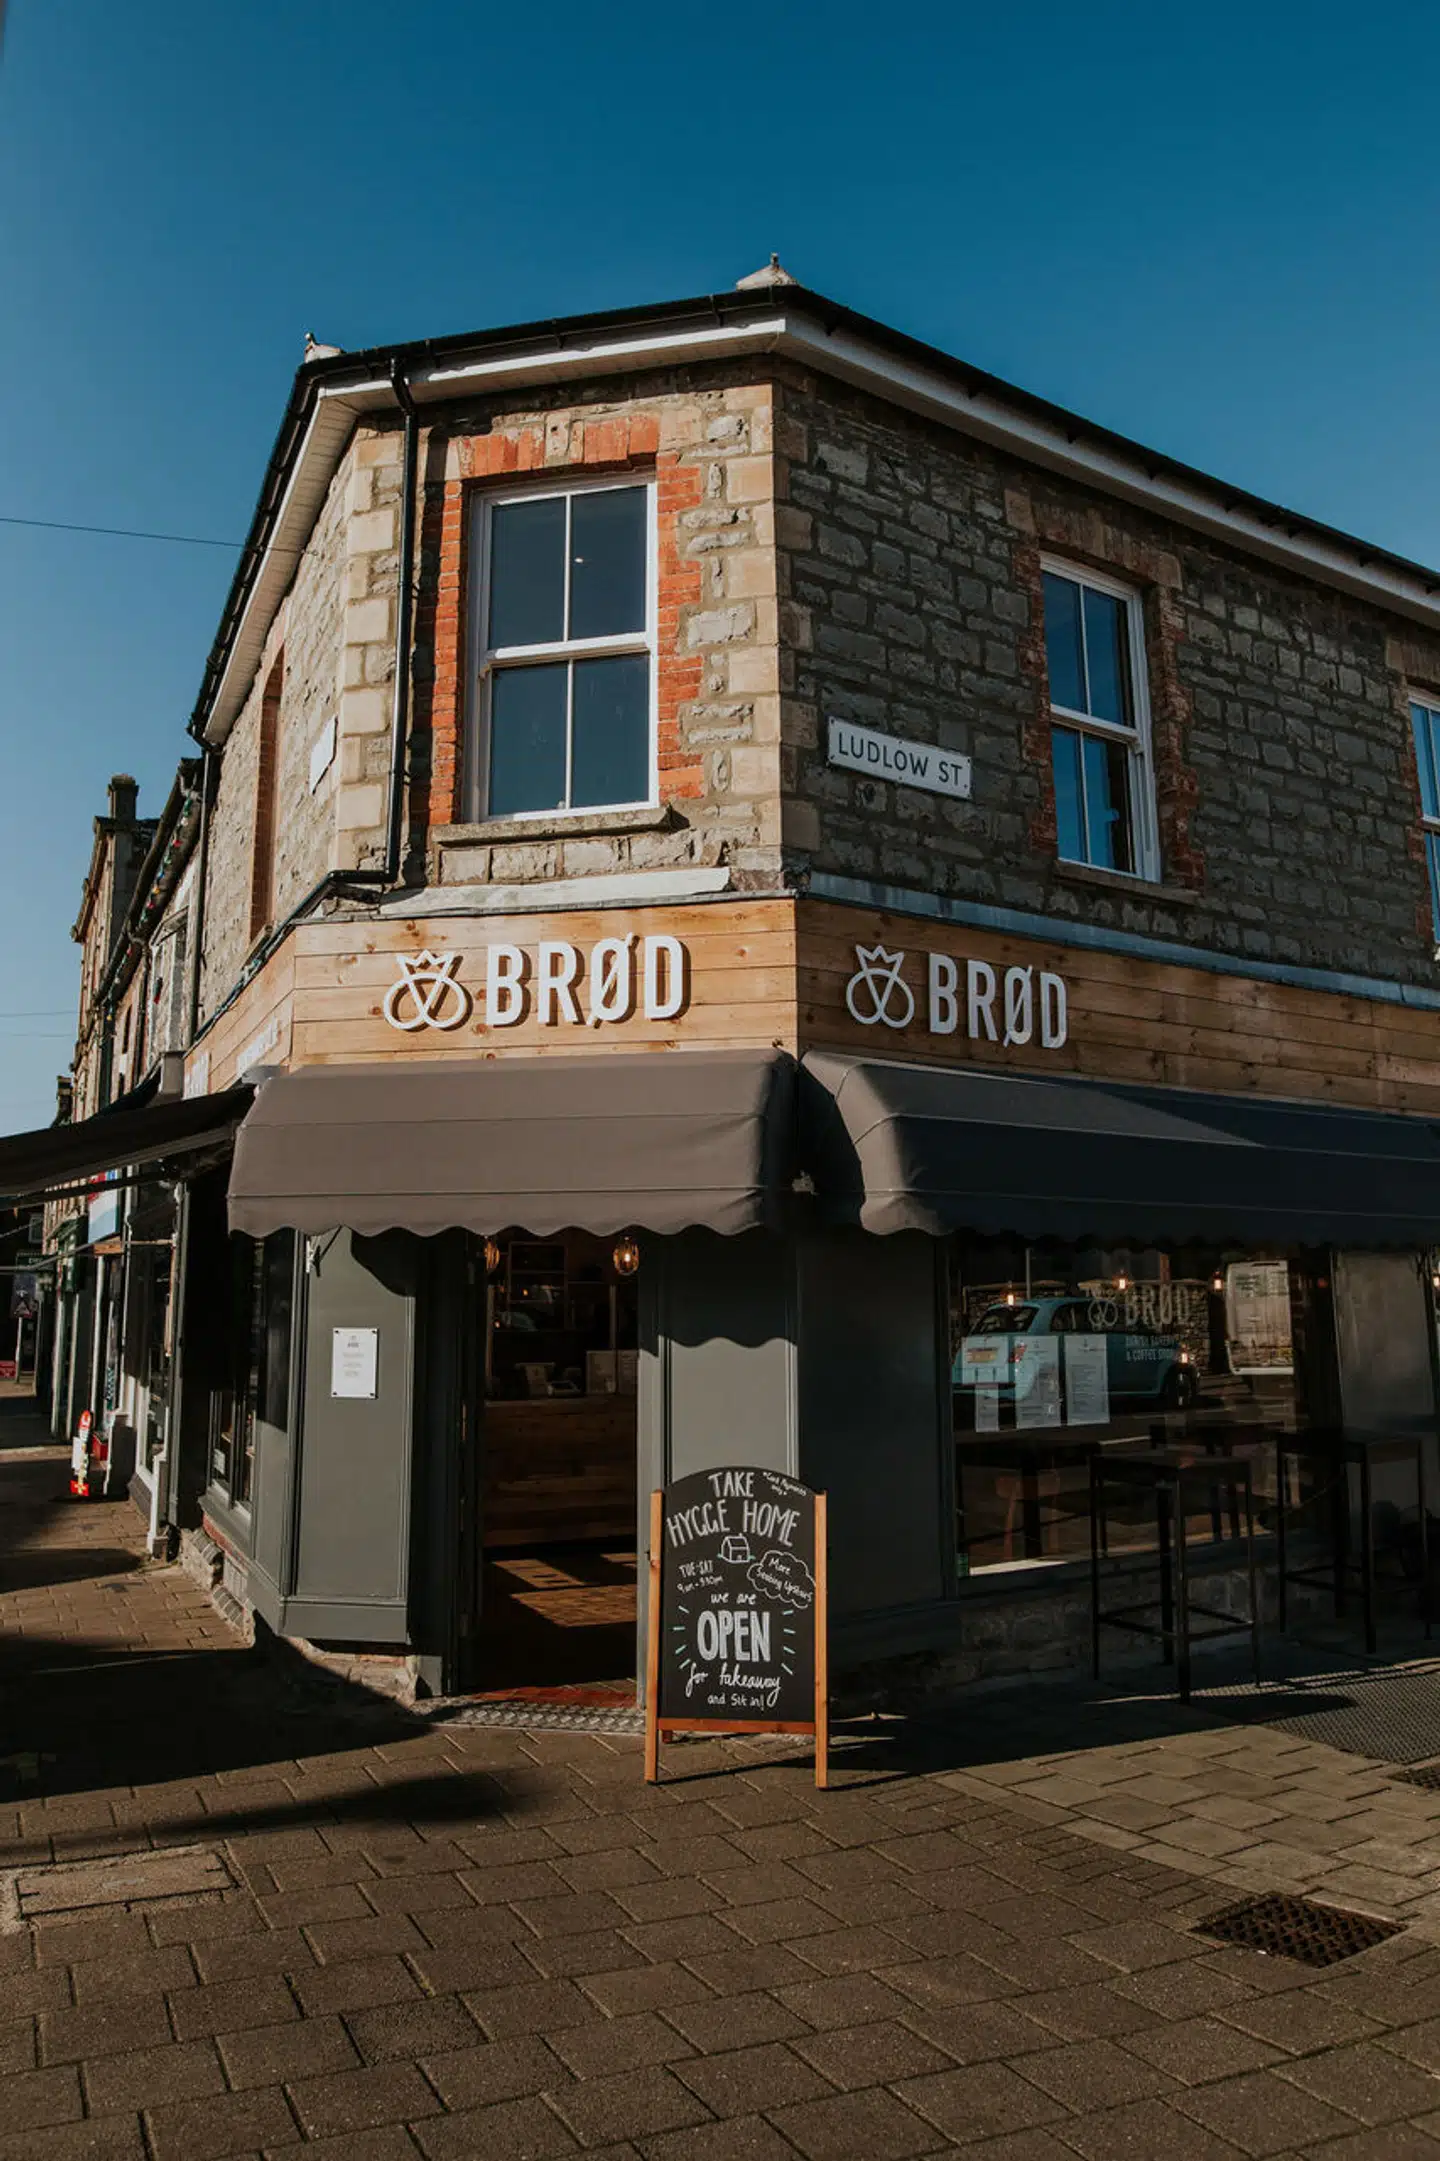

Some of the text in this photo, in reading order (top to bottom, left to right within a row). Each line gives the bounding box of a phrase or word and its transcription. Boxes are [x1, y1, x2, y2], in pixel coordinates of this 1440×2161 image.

[838, 732, 963, 786] LUDLOW ST
[485, 932, 685, 1028] BRØD
[928, 952, 1067, 1049] BRØD
[1124, 1284, 1189, 1331] BRØD
[708, 1471, 755, 1498] TAKE
[666, 1499, 801, 1548] HYGGE HOME
[768, 1557, 790, 1575] More
[710, 1592, 757, 1605] we are
[697, 1609, 771, 1663] OPEN
[685, 1661, 781, 1708] for takeaway
[707, 1692, 726, 1705] and
